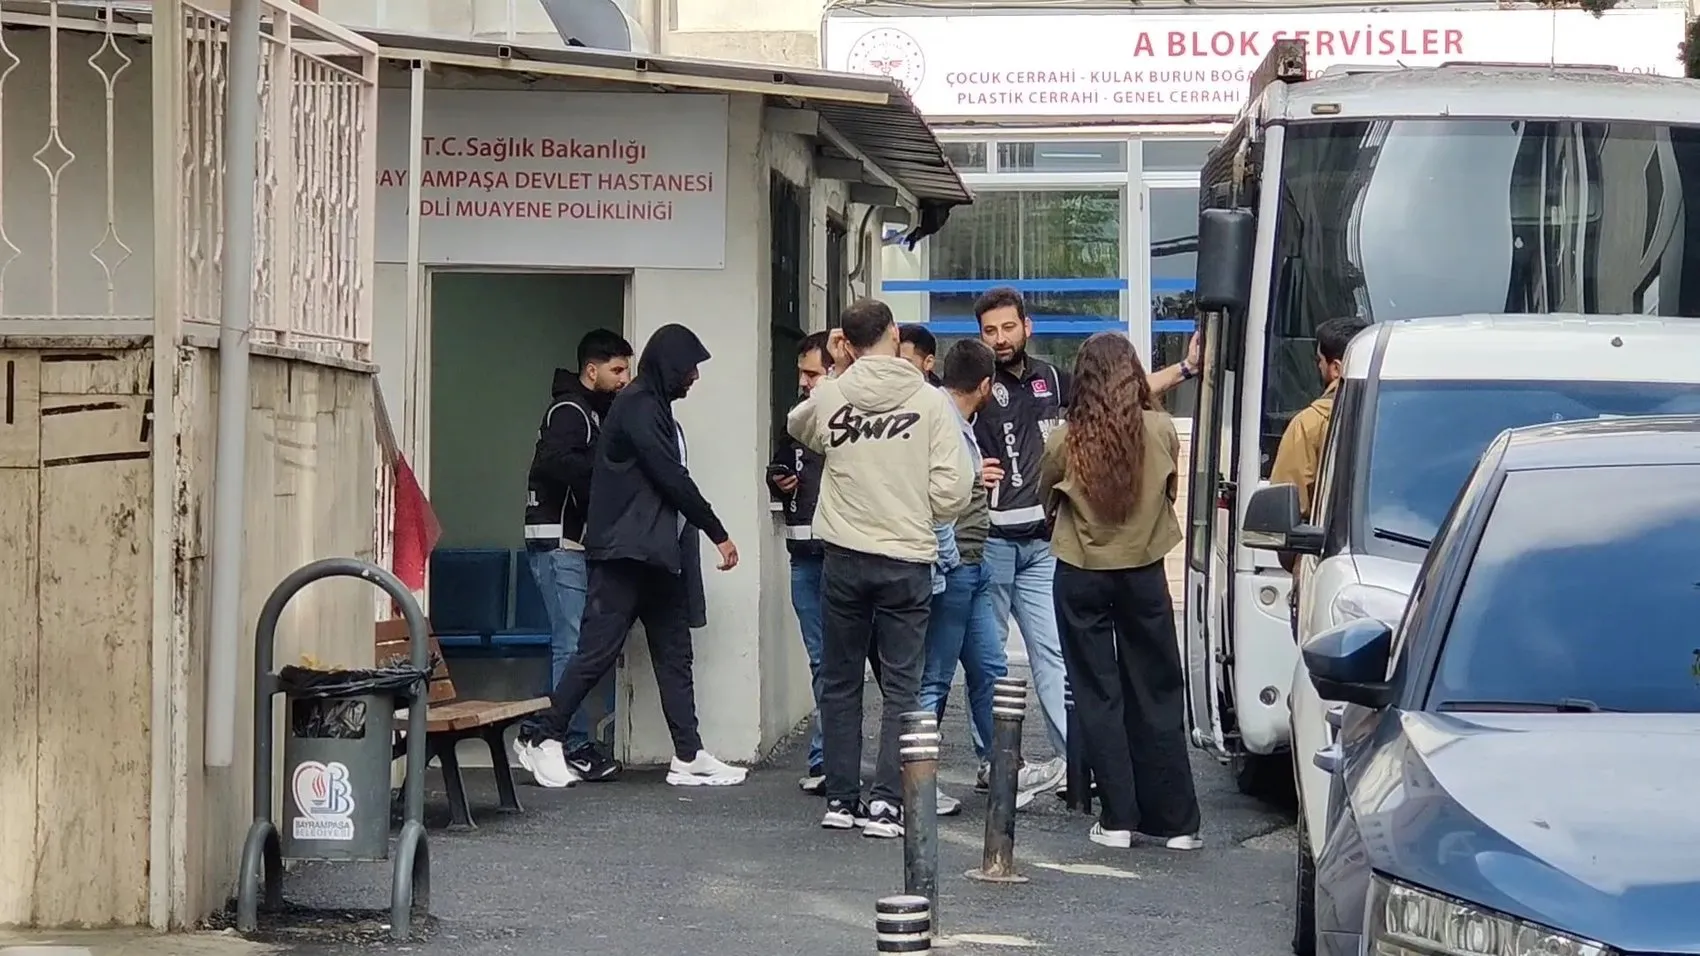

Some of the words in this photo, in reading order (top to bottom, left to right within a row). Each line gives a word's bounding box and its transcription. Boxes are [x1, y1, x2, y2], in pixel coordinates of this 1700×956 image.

[1133, 31, 1155, 57] A
[1168, 31, 1260, 57] BLOK
[946, 72, 1001, 88] ÇOCUK
[1006, 69, 1075, 84] CERRAHİ
[1090, 71, 1143, 83] KULAK
[1150, 70, 1205, 83] BURUN
[957, 89, 1023, 104] PLASTİK
[1029, 88, 1098, 103] CERRAHİ
[1113, 91, 1164, 103] GENEL
[1169, 88, 1240, 103] CERRAHİ
[541, 138, 646, 164] Bakanlığı
[376, 169, 509, 192] AYAMPAŞA
[515, 171, 593, 189] DEVLET
[598, 172, 713, 192] HASTANESİ
[406, 197, 450, 217] DLİ
[455, 200, 552, 218] MUAYENE
[558, 199, 672, 220] POLİKLİNİĞİ
